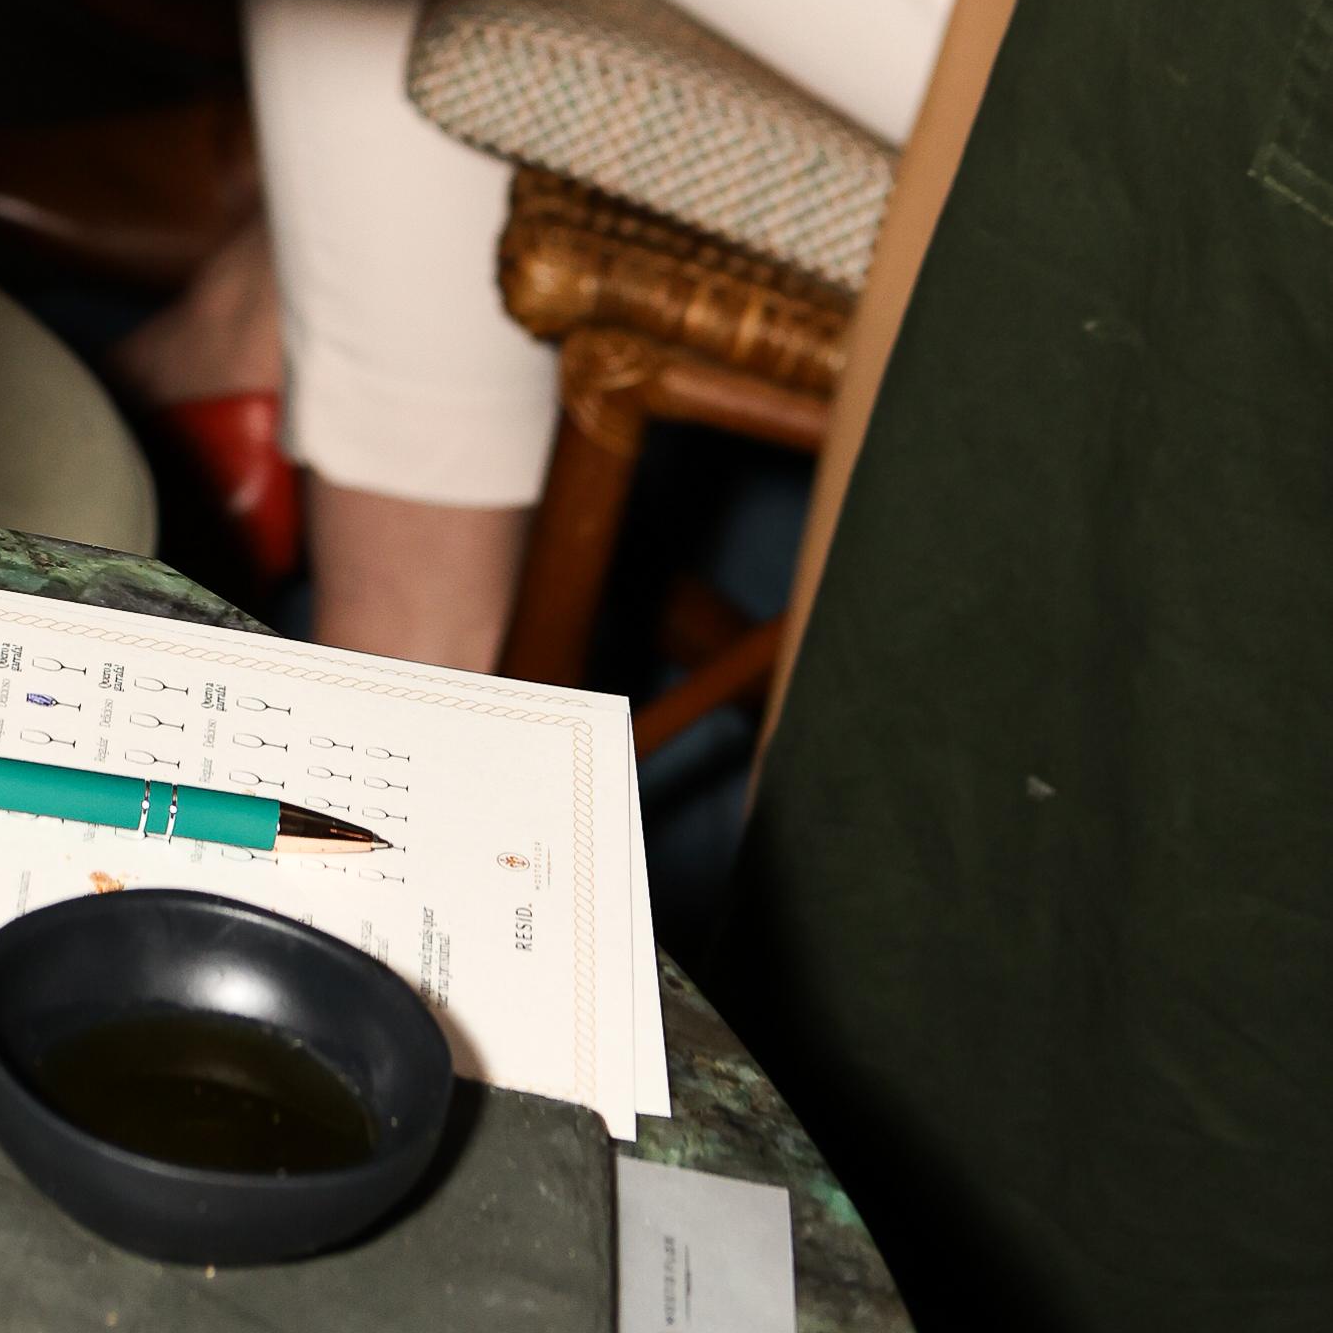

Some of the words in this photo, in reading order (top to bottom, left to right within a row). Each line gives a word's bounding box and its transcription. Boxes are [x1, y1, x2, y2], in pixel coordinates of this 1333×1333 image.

[98, 666, 112, 689] Quero
[201, 686, 215, 709] Quero
[514, 903, 533, 950] RESID.
